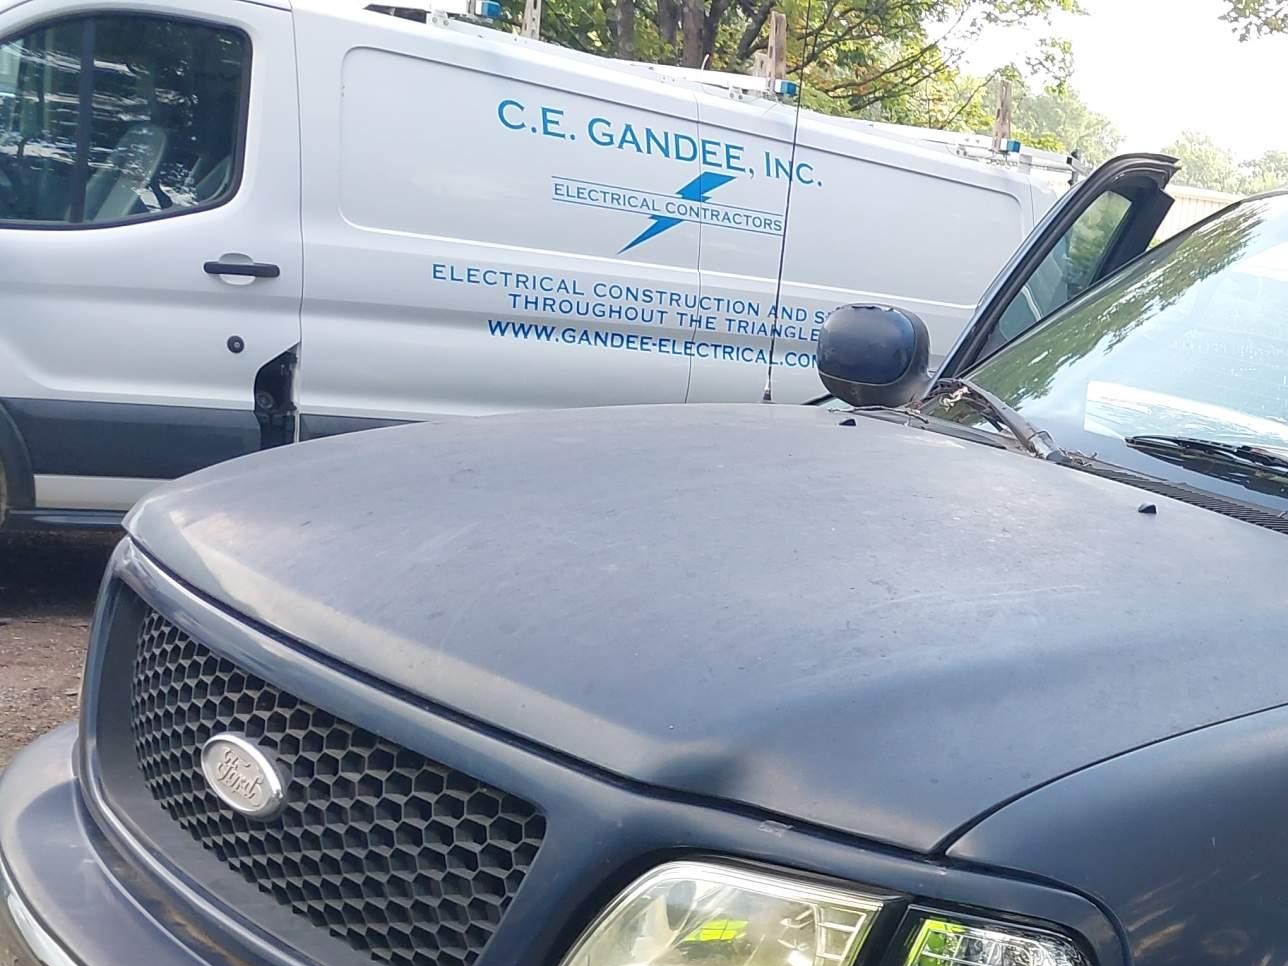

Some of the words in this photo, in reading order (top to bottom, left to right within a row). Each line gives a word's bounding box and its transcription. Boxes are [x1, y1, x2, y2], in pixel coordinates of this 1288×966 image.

[497, 99, 576, 140] C.E.
[587, 117, 754, 180] GANDEE,
[764, 151, 823, 188] INC.
[554, 183, 661, 211] ELECTRICAL
[665, 201, 783, 232] CONTRACTORS
[432, 263, 585, 296] ELECTRICAL
[593, 283, 760, 317] CONSTRUCTION
[768, 304, 808, 322] AND
[814, 310, 831, 325] S
[508, 293, 668, 325] THROUGHOUT
[676, 312, 717, 331] THE
[725, 318, 820, 342] TRIANGLE
